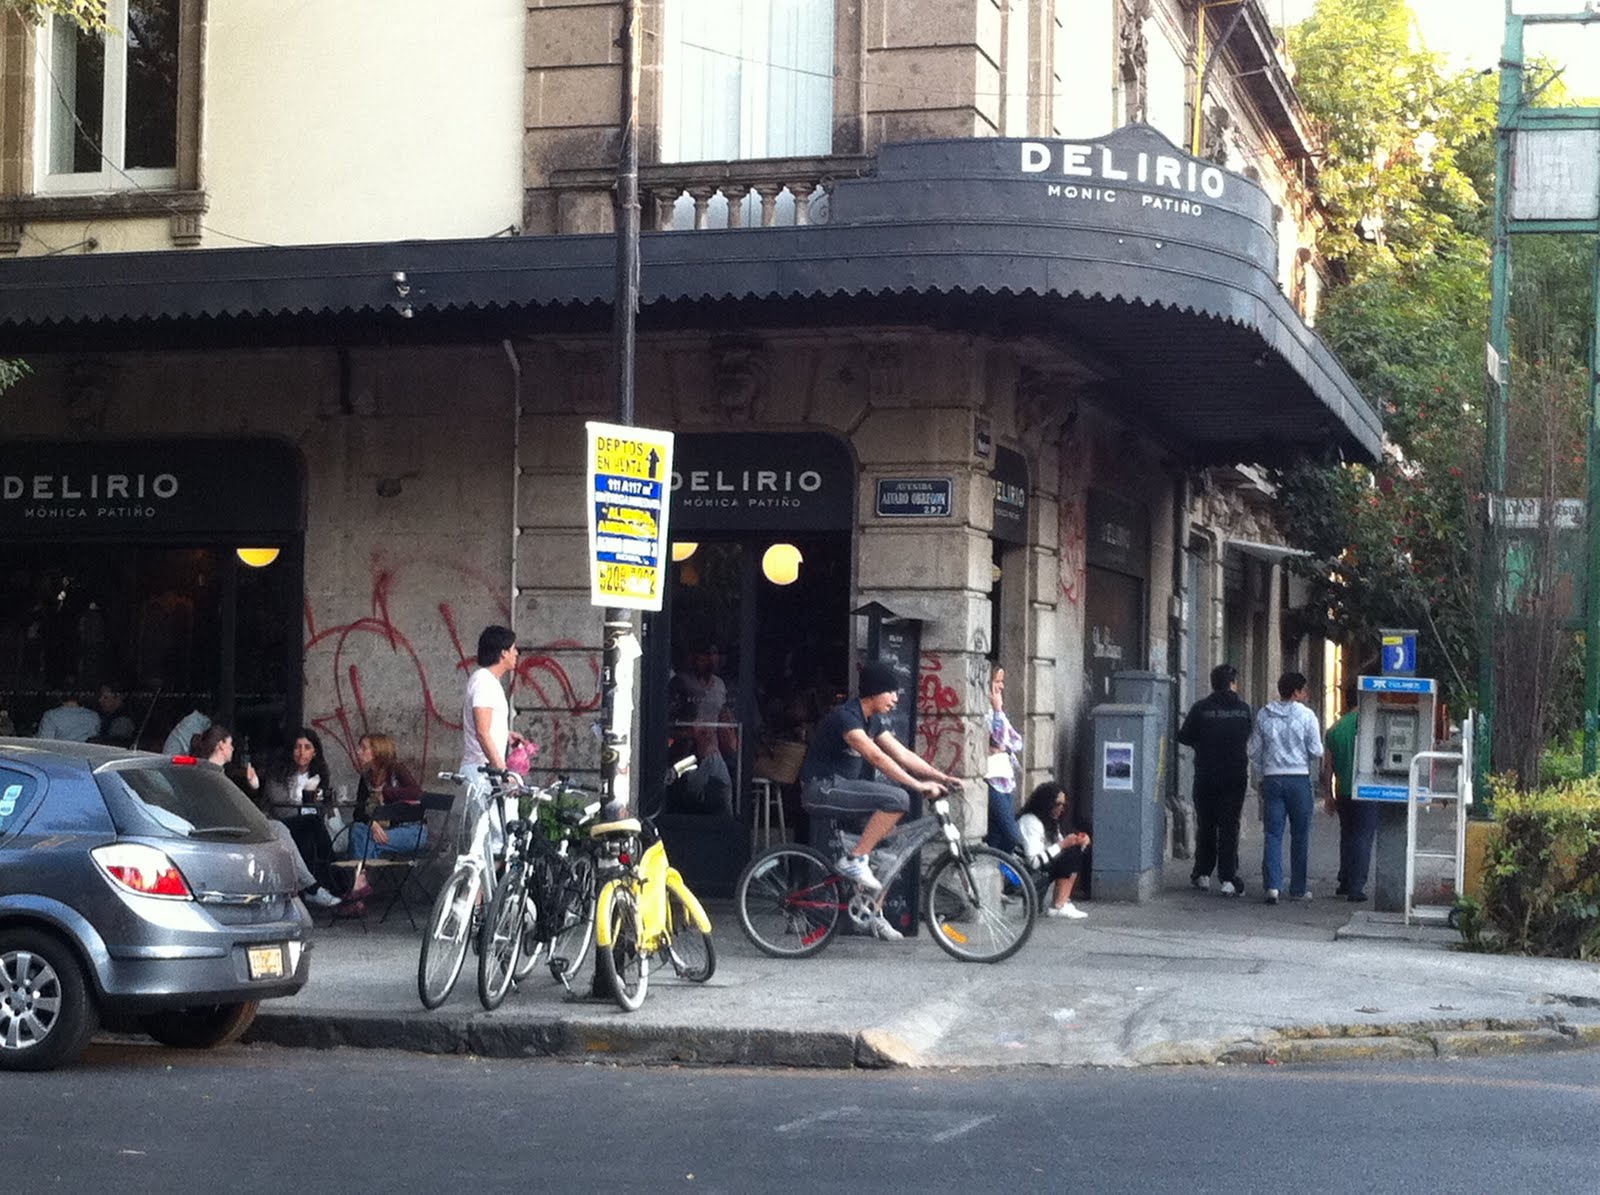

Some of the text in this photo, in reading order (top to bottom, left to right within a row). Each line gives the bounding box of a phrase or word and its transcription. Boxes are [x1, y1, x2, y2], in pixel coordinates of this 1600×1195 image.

[1020, 142, 1225, 199] DELIRIO
[1047, 185, 1202, 217] MONIC PATIÑO
[597, 437, 644, 456] DEPTOS
[597, 455, 610, 470] EN
[3, 473, 179, 500] DELIRIO
[25, 504, 156, 518] MÓNICA PATIÑO
[684, 496, 802, 507] MÓNICA PATIÑO
